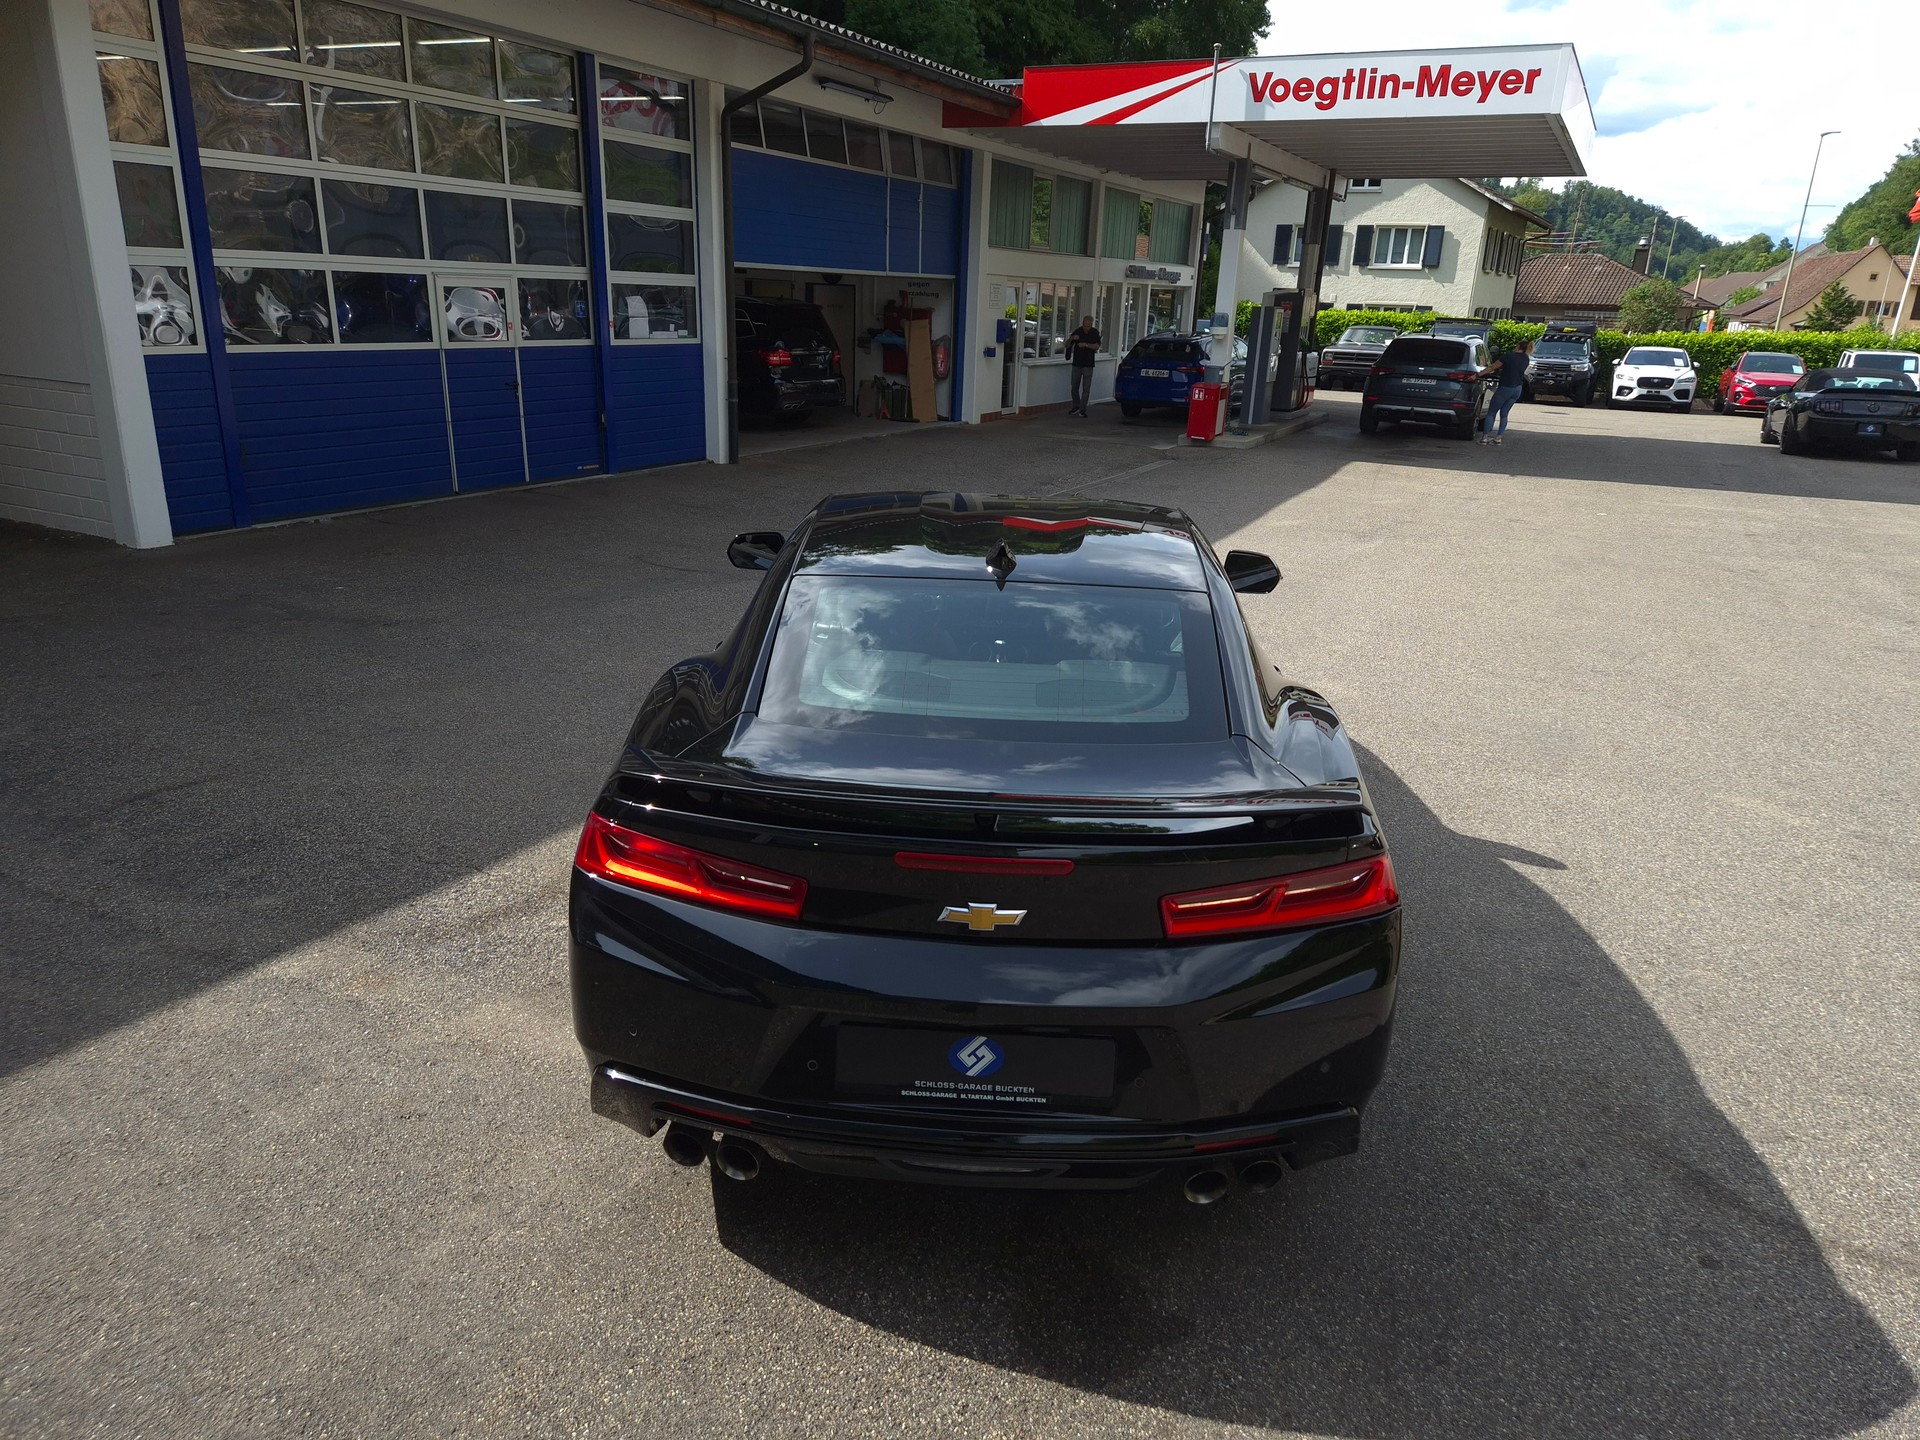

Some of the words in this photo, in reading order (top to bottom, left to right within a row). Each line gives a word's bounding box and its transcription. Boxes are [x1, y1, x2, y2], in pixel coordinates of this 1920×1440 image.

[1249, 64, 1541, 111] Voegtlin-Meyer
[899, 290, 940, 299] Brzahlung
[914, 1080, 993, 1092] SCHLOSS-GARAGE
[995, 1085, 1035, 1094] BUCKTEN
[901, 1090, 957, 1099] SCHLOSS-GARAGE
